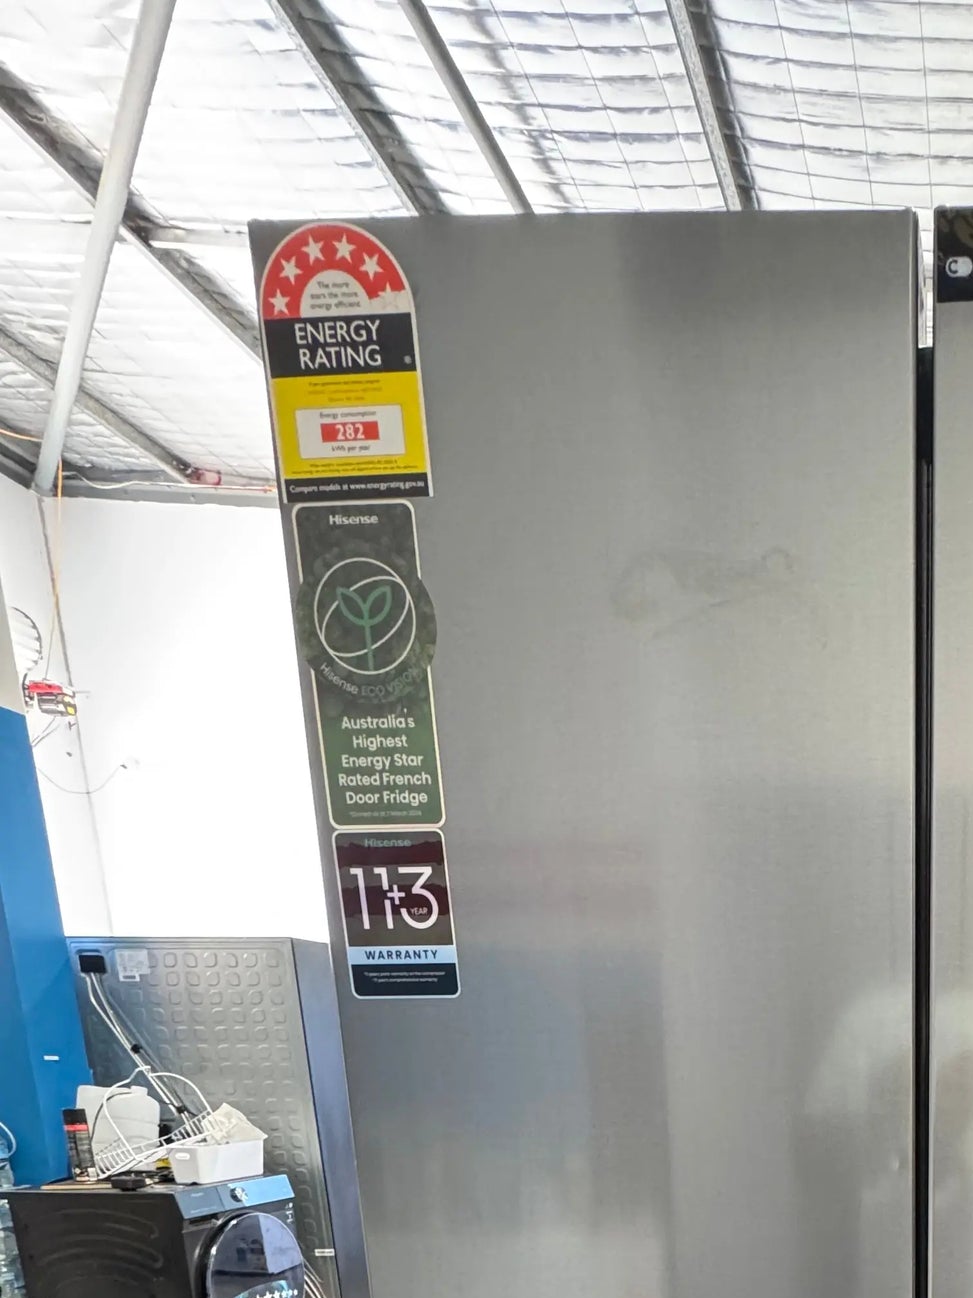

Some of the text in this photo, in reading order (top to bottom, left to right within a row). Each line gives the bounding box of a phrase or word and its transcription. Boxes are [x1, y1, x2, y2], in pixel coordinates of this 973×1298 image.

[294, 319, 380, 345] ENERGY
[299, 345, 382, 370] RATING
[335, 423, 365, 440] 282
[329, 514, 379, 525] Hisense
[320, 662, 359, 695] Hisense
[361, 685, 385, 697] ECO
[341, 708, 416, 730] Australia's
[352, 734, 408, 751] Highest
[341, 753, 424, 770] Energy Star
[338, 771, 431, 787] Rated French
[345, 790, 428, 806] Door Fridge
[364, 838, 412, 848] Hisense
[410, 907, 428, 915] YEAR
[365, 950, 438, 961] WARRANTY
